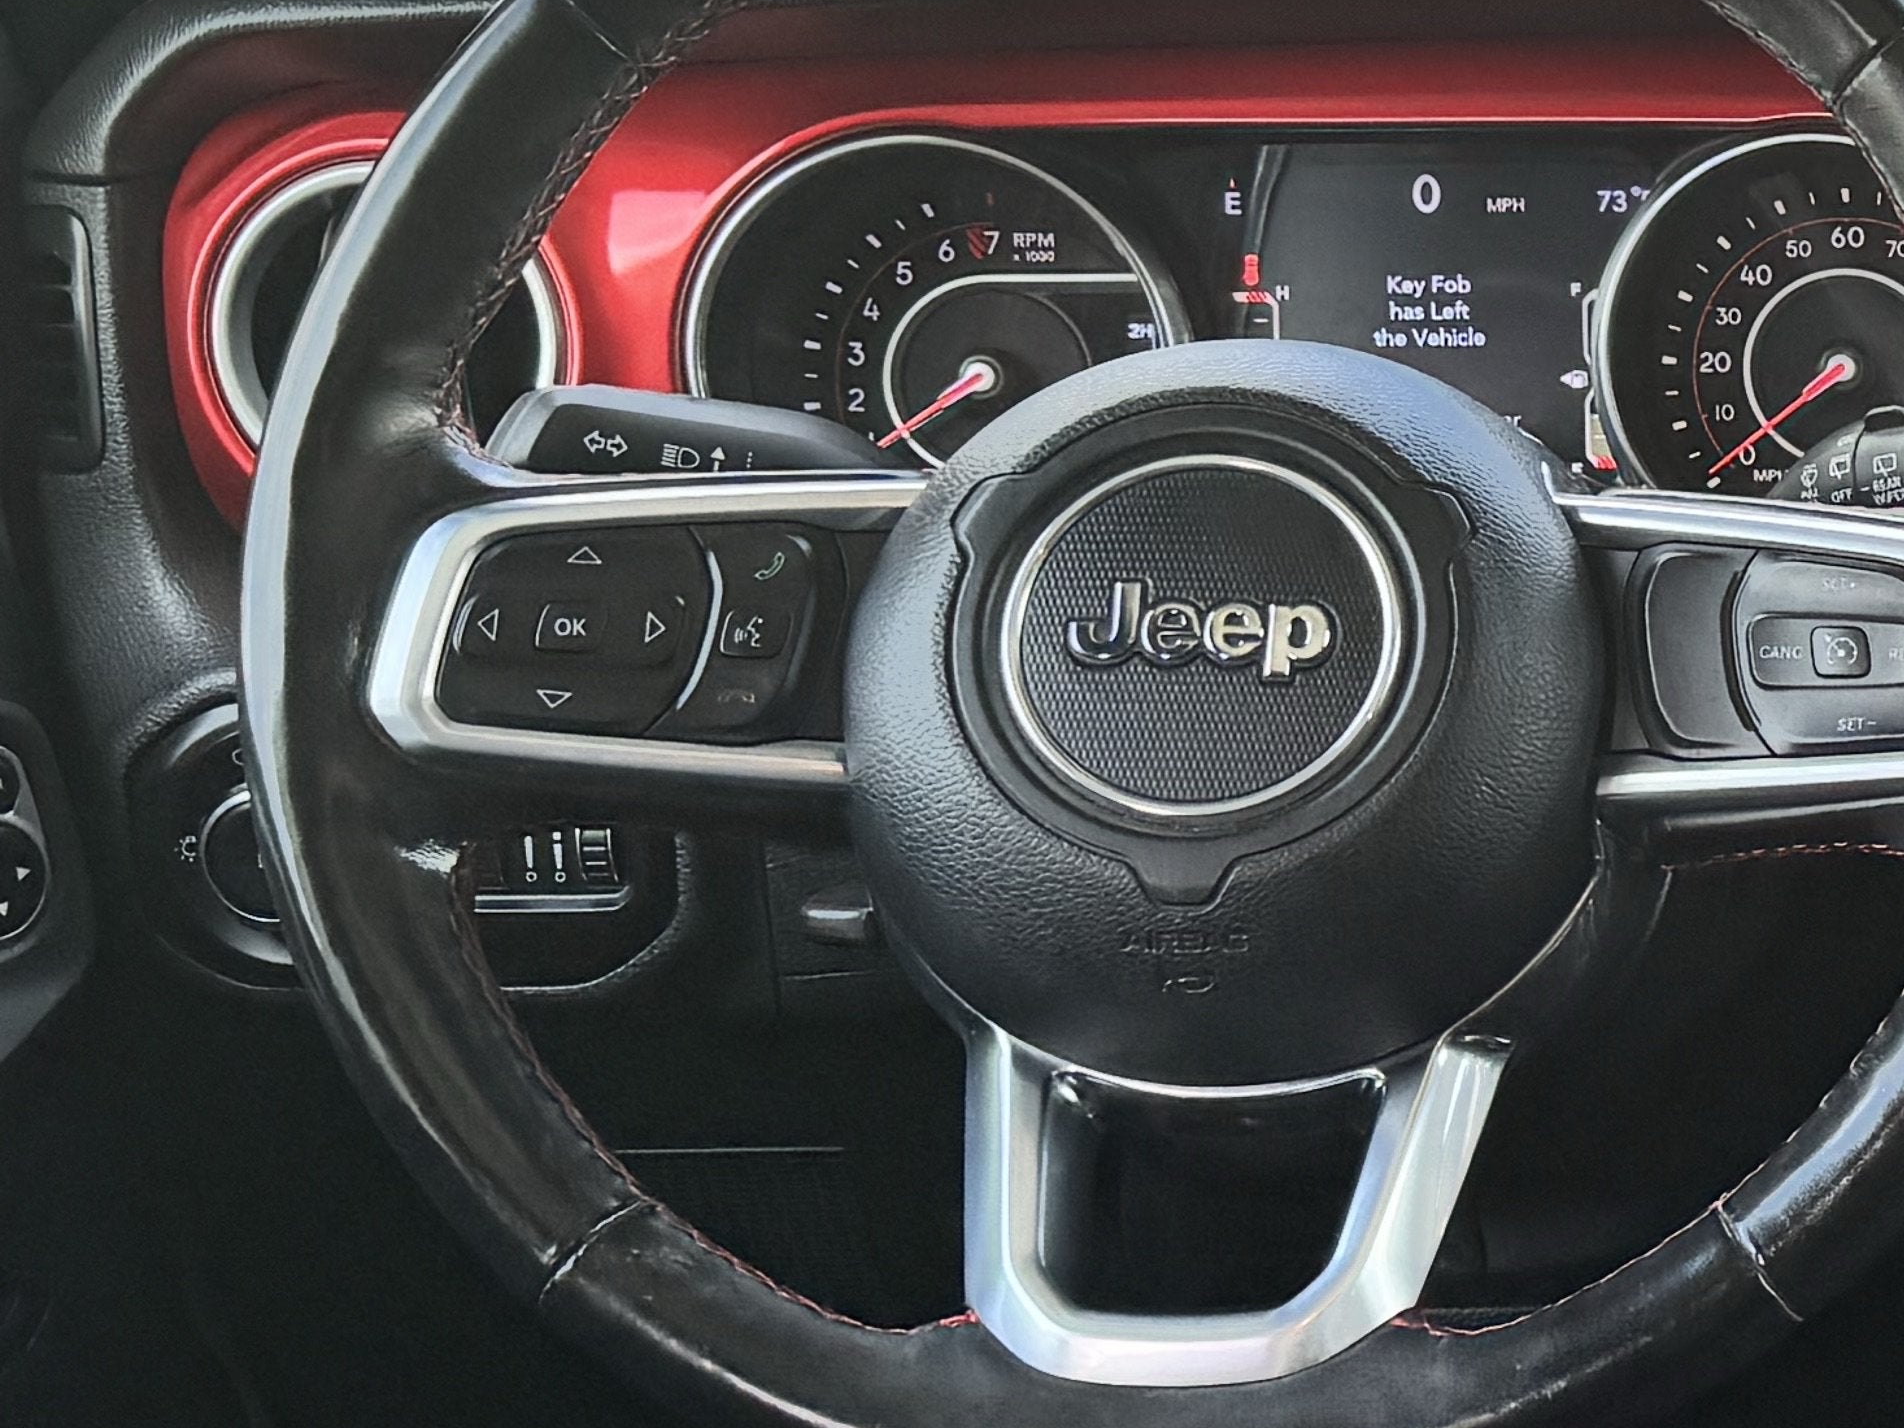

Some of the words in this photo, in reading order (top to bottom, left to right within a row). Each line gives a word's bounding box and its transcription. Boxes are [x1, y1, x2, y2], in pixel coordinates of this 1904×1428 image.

[1224, 191, 1243, 216] E
[1411, 173, 1442, 214] 0
[1486, 197, 1526, 213] MPH
[984, 230, 1001, 255] 7
[1012, 232, 1056, 248] RPM
[1830, 226, 1866, 248] 60
[938, 238, 955, 263] 6
[1785, 240, 1812, 259] 50
[895, 261, 914, 285] 5
[1740, 264, 1773, 287] 40
[1275, 285, 1290, 301] H
[1386, 275, 1427, 296] Key
[1431, 274, 1472, 294] Fob
[1570, 282, 1582, 298] F
[862, 297, 881, 322] 4
[1389, 300, 1426, 321] has
[1430, 300, 1471, 321] Left
[1715, 307, 1742, 325] 30
[1373, 328, 1408, 348] the
[1411, 327, 1487, 348] Vehicle
[847, 341, 866, 367] 3
[1699, 351, 1732, 373] 20
[847, 387, 866, 412] 2
[1714, 403, 1735, 421] 10
[553, 617, 587, 637] OK
[1066, 579, 1337, 681] Jeep
